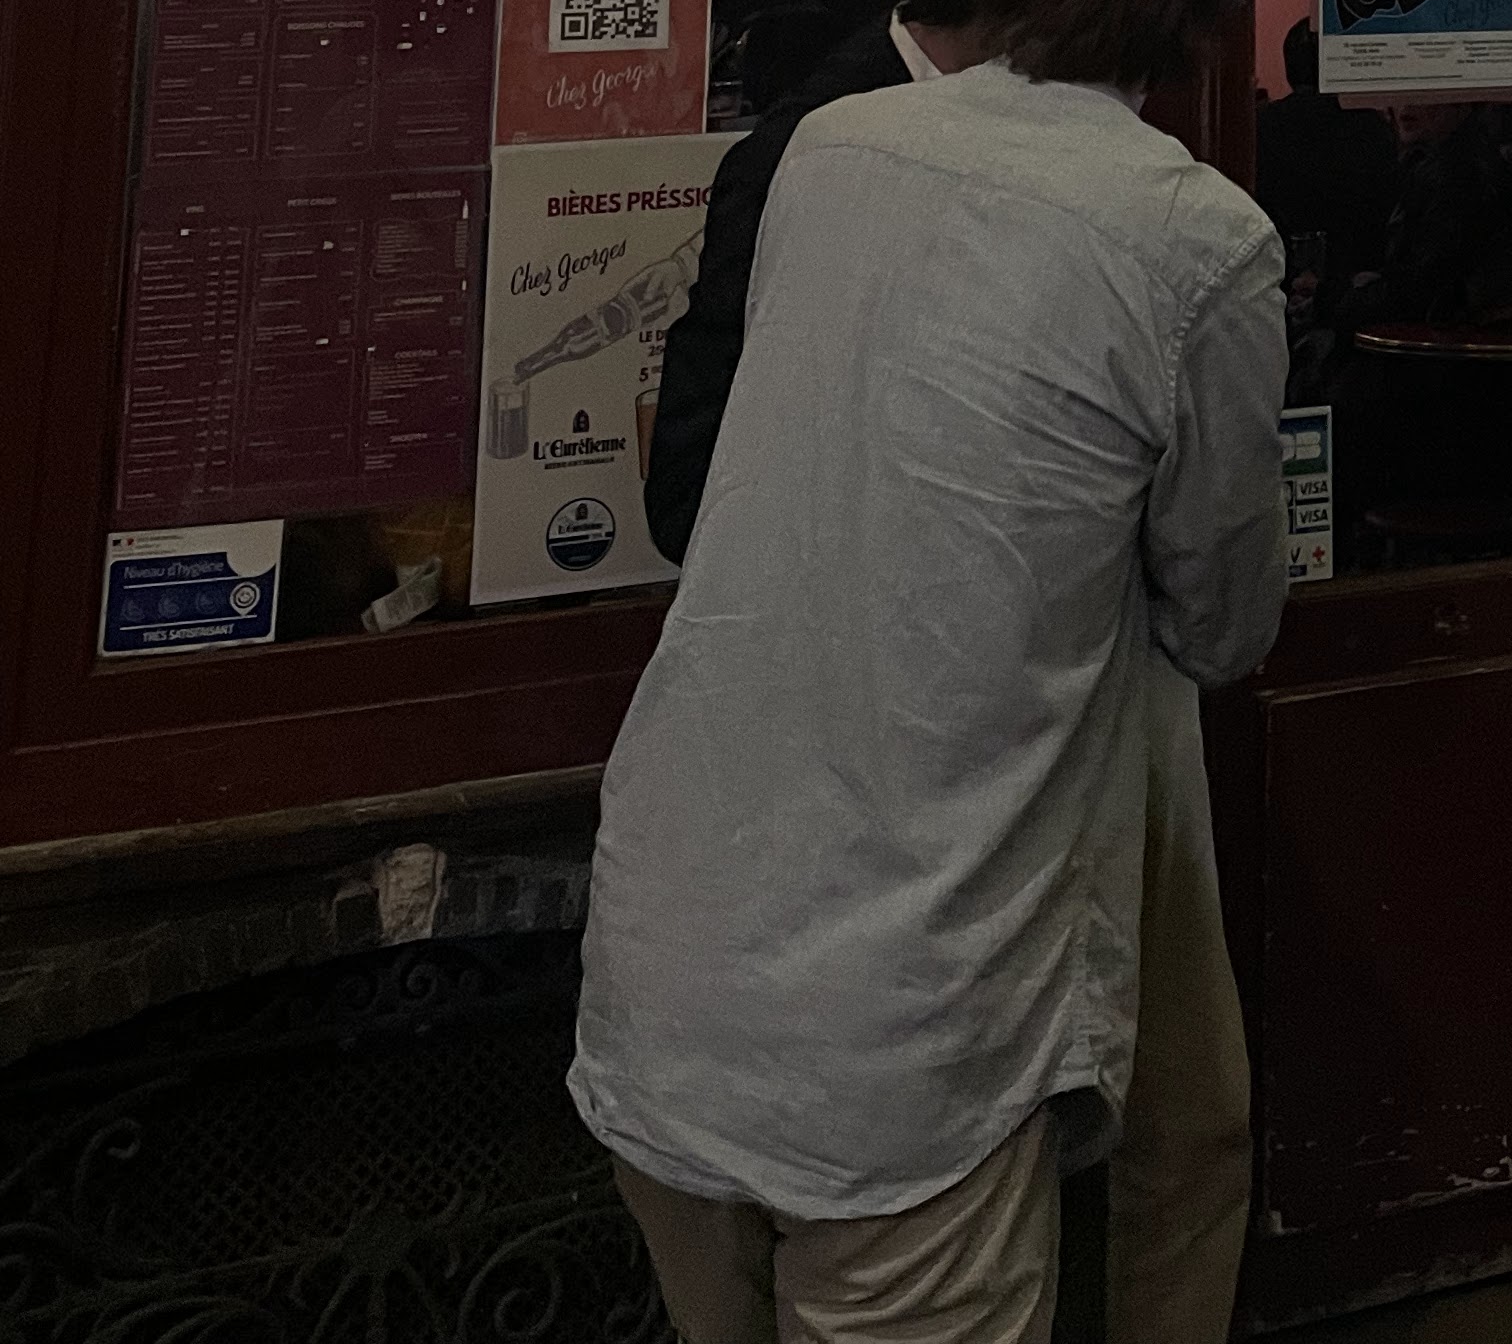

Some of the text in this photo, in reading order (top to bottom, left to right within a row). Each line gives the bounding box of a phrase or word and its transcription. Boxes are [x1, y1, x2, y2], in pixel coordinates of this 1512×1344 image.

[546, 76, 587, 111] Chez
[547, 189, 621, 218] BIÈRES
[510, 240, 627, 297] Chez Georges
[639, 330, 653, 343] LE
[1299, 481, 1328, 495] VISA
[1299, 509, 1328, 524] VISA
[123, 566, 164, 579] Niveau
